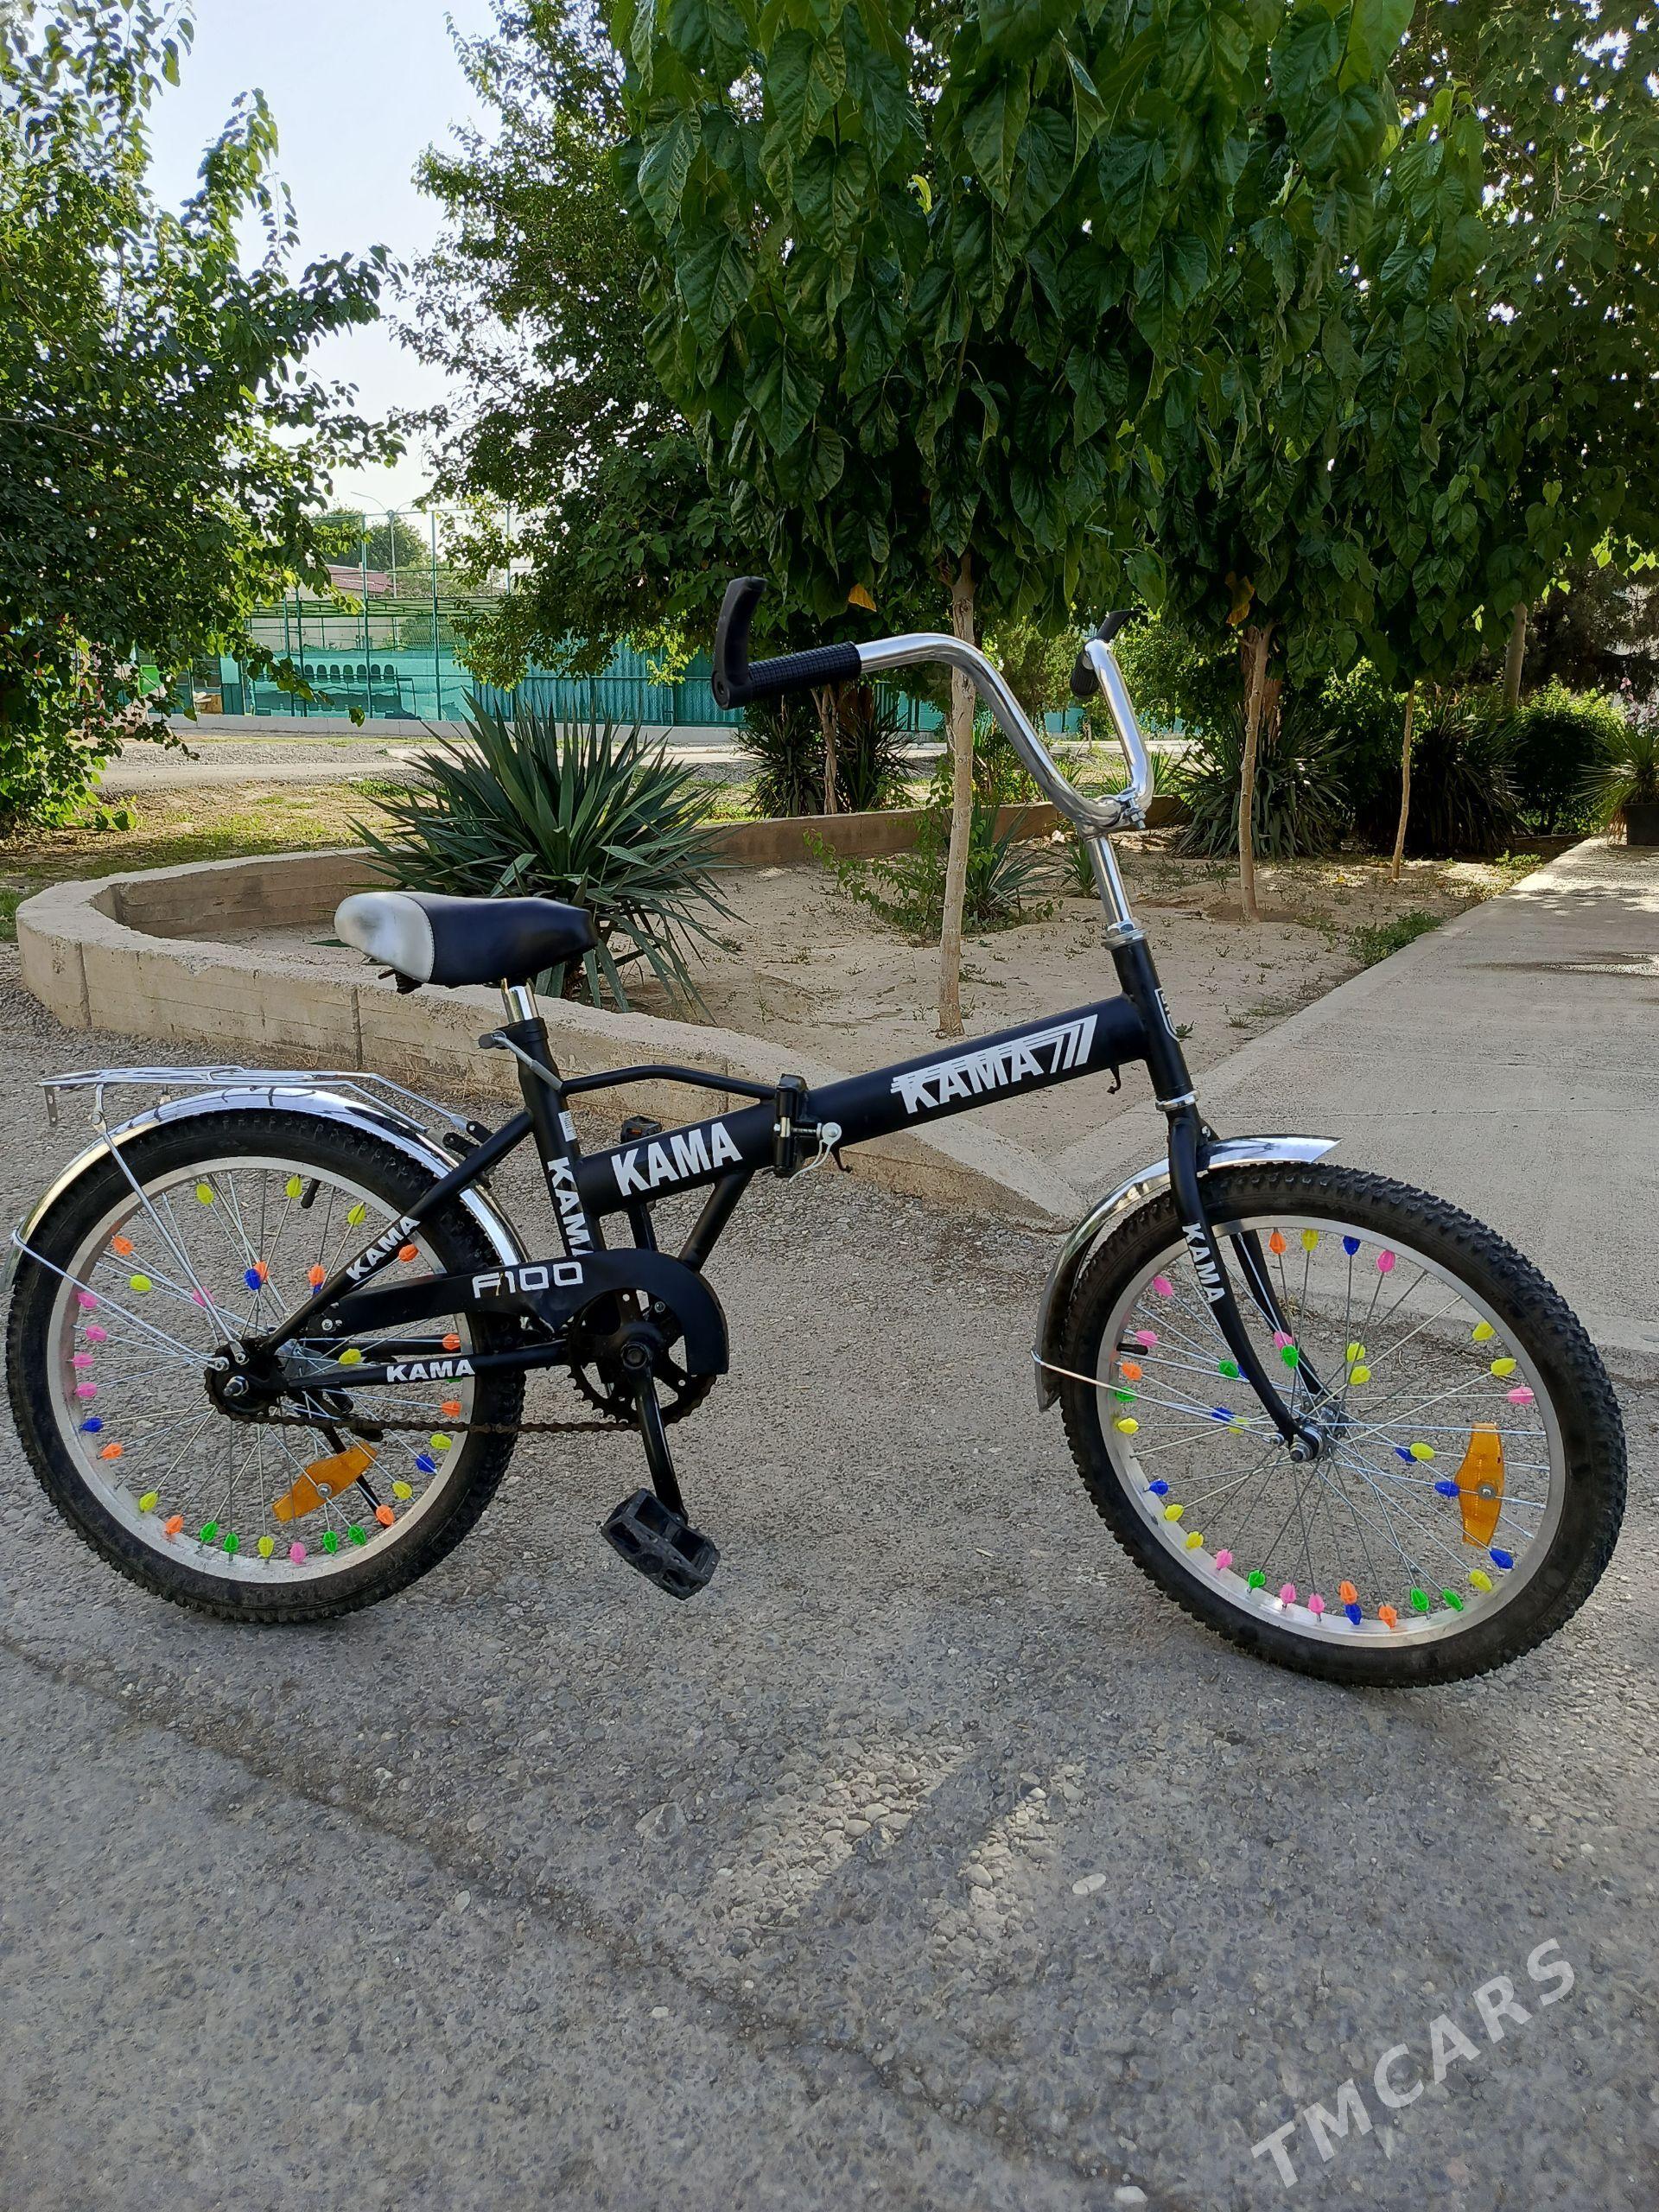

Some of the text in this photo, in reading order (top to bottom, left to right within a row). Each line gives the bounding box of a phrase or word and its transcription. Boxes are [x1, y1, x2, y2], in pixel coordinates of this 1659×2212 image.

[891, 1039, 1044, 1115] KAMA
[611, 1122, 743, 1197] KAMA
[346, 1216, 422, 1281] KAMA
[472, 1261, 584, 1299] F100
[1181, 1222, 1225, 1303] KAMA
[386, 1359, 475, 1382] KAMA
